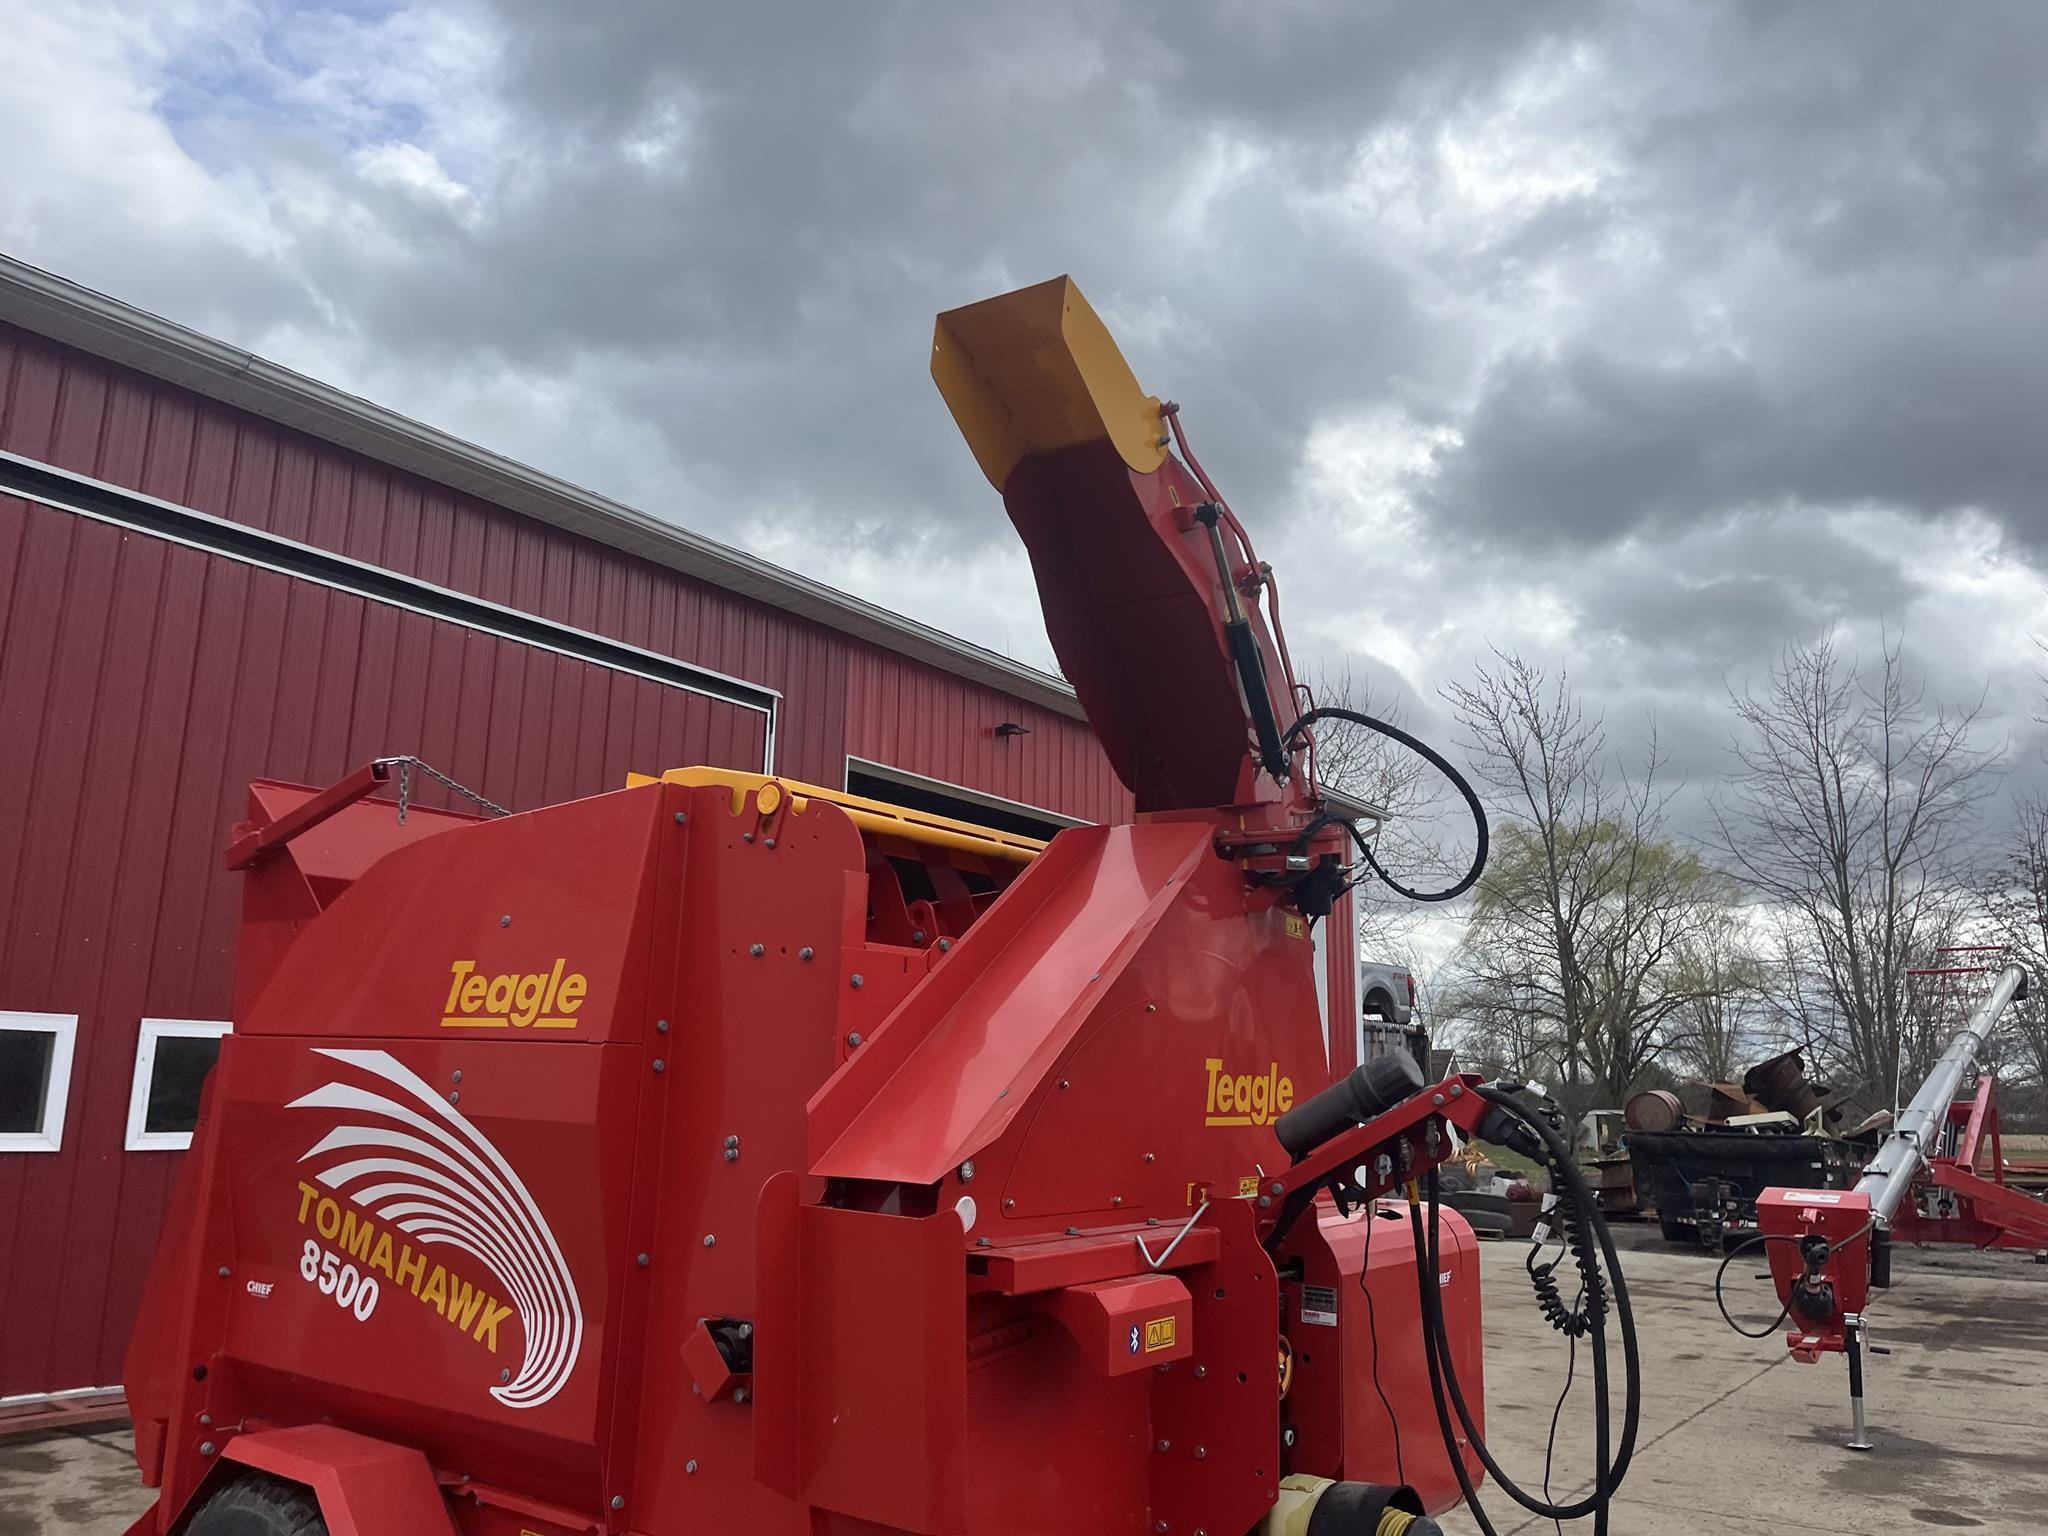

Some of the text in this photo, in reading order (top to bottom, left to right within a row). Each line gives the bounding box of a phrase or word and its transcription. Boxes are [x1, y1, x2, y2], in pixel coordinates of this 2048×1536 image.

[444, 958, 588, 1026] Teagle
[1205, 1058, 1294, 1125] Teagle
[246, 1280, 275, 1295] CHIEF
[297, 1180, 514, 1354] TOMAHAWK
[299, 1239, 379, 1322] 8500
